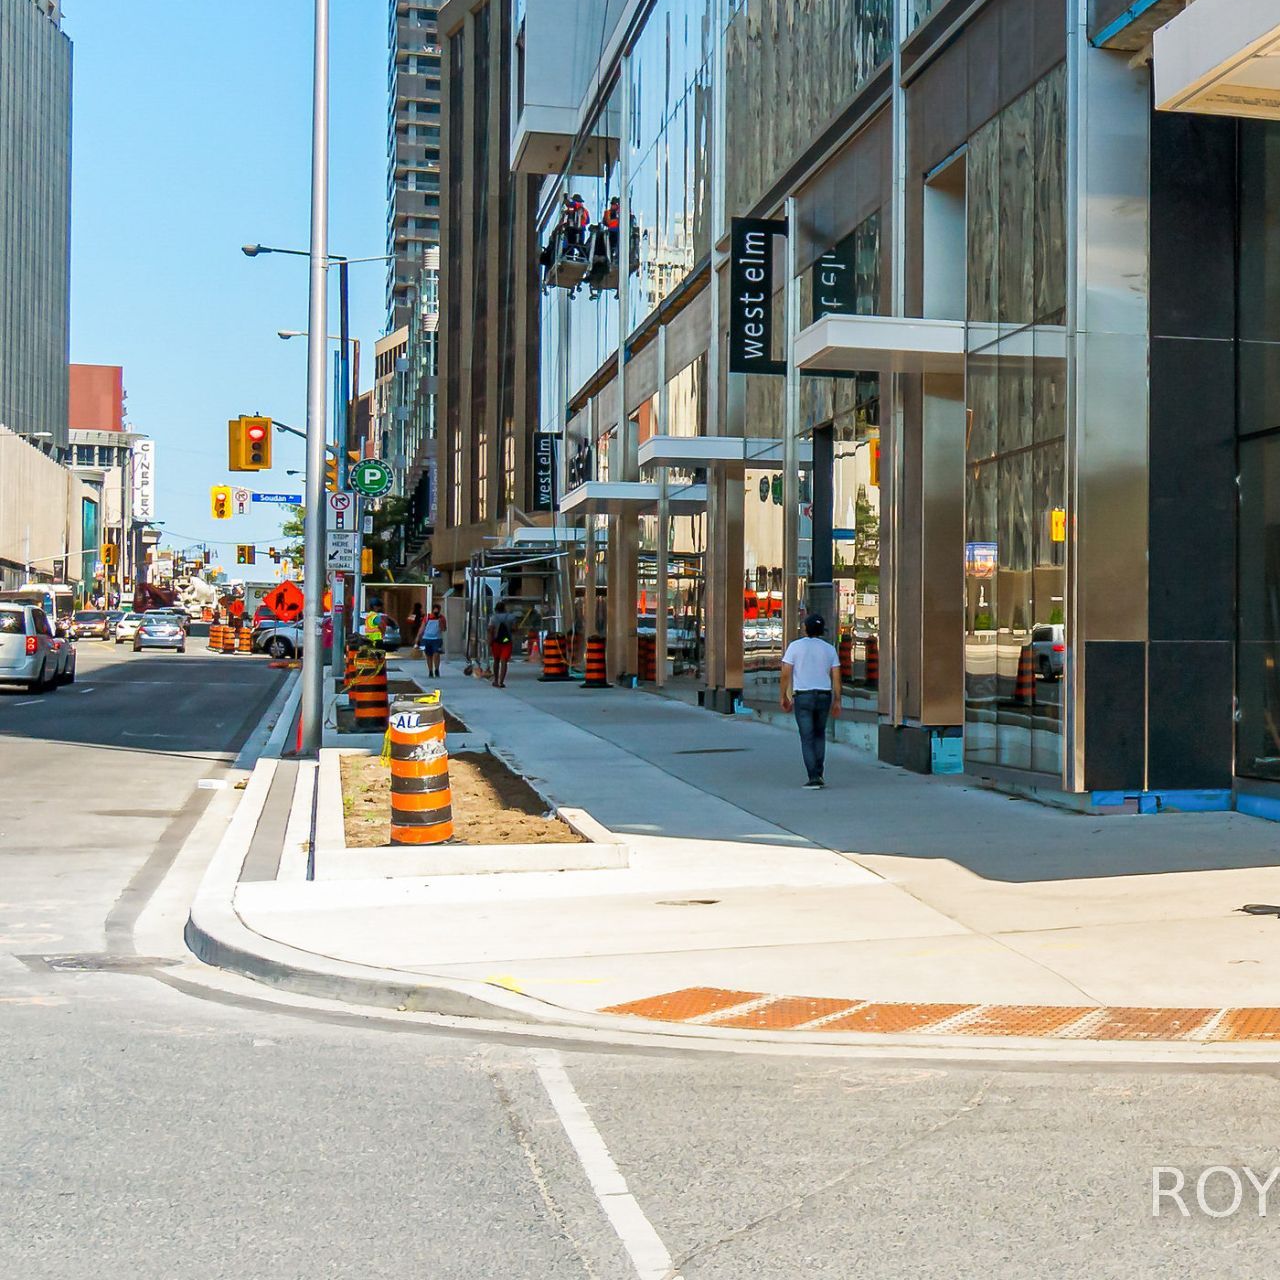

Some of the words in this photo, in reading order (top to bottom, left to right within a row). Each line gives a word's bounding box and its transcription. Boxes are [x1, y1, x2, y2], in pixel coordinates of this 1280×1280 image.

[739, 231, 765, 282] elm
[739, 292, 765, 359] west
[537, 439, 552, 465] elm
[141, 444, 150, 516] CINEPLEX
[364, 468, 382, 484] P
[537, 470, 552, 504] west
[259, 494, 287, 502] Soudan
